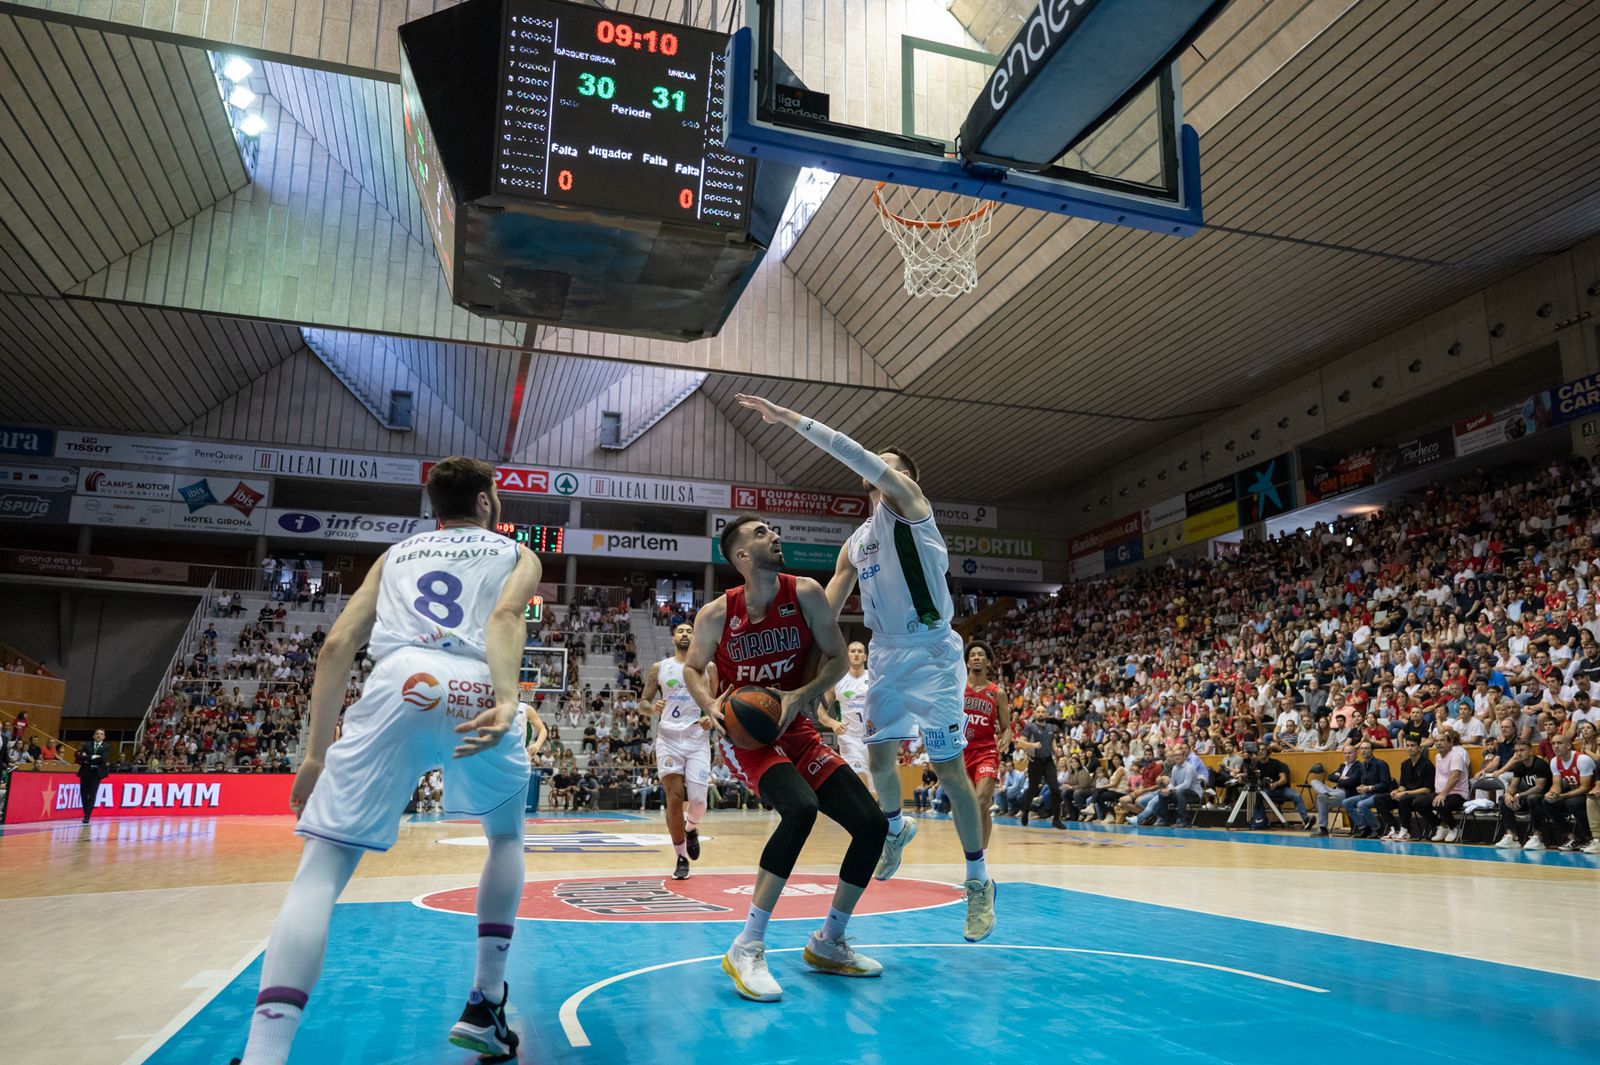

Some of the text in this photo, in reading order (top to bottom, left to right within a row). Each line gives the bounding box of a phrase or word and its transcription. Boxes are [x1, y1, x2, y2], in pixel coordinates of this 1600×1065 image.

[596, 20, 679, 56] 09:10
[990, 0, 1086, 111] ende
[577, 72, 615, 99] 30
[652, 86, 686, 112] 31
[778, 93, 800, 107] liga
[551, 143, 578, 157] Falta
[588, 145, 633, 161] Jugador
[642, 153, 668, 167] Falta
[675, 163, 700, 177] Falta
[558, 170, 573, 190] 0
[679, 189, 693, 209] 0
[65, 442, 112, 453] TISSOT
[194, 448, 243, 462] PereQuera
[280, 454, 323, 475] LLEAL
[330, 457, 378, 479] TULSÀ
[100, 480, 170, 491] CAMPS MOTOR
[611, 479, 649, 499] LLEAL
[654, 483, 694, 502] TULSÀ
[233, 488, 255, 507] ibis
[761, 490, 832, 503] EQUIPACIONS
[765, 498, 828, 510] ESPORTIVES
[183, 515, 252, 527] HOTEL GIRONA
[326, 513, 419, 534] infoself
[324, 529, 359, 541] group
[516, 531, 528, 541] 31
[607, 533, 678, 552] parlem
[18, 554, 82, 566] girona ets tu
[414, 570, 464, 629] 8
[727, 626, 800, 662] GIRONA
[737, 654, 797, 682] FIATC
[448, 693, 495, 708] DEL SO
[671, 706, 681, 718] 6
[121, 782, 222, 809] DAMM
